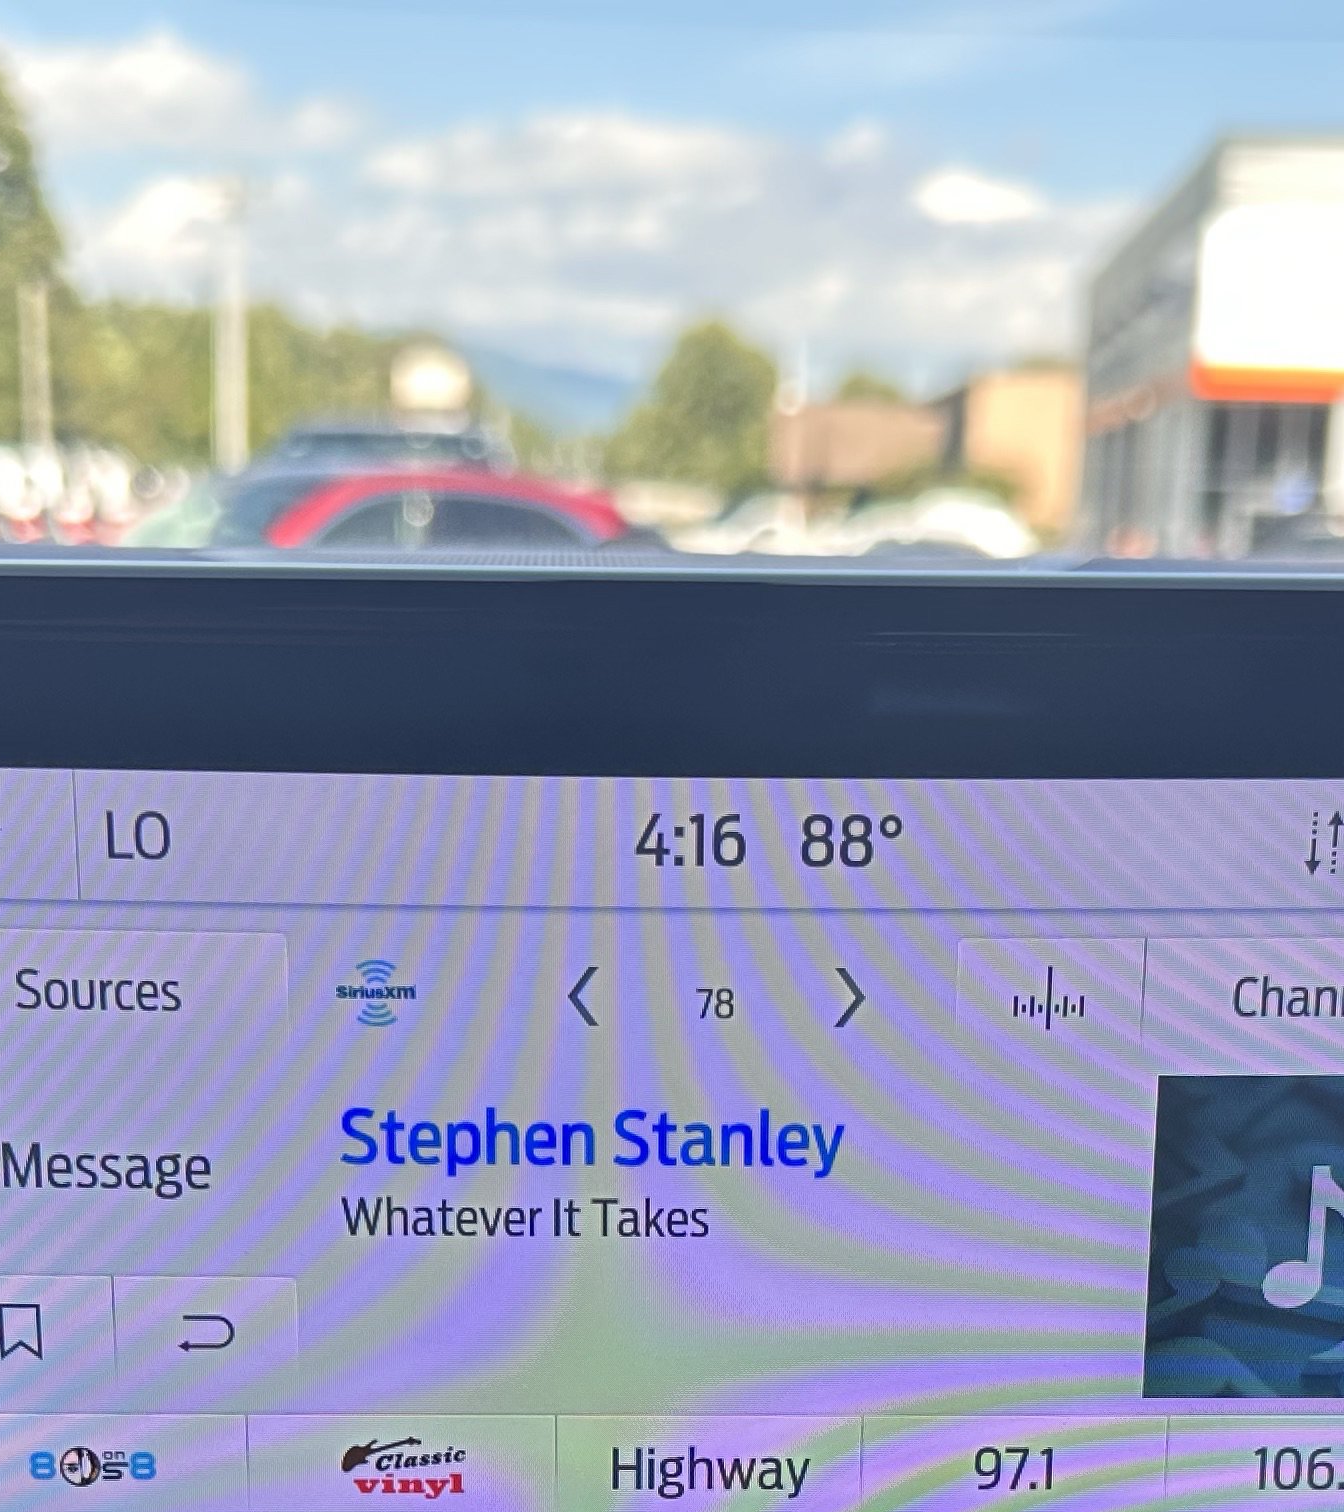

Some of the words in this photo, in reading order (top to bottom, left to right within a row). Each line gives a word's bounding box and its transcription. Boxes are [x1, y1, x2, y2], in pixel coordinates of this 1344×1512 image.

[105, 808, 172, 861] LO
[634, 812, 747, 868] 4:16
[14, 967, 183, 1013] Sources
[696, 987, 736, 1020] 78
[340, 1107, 596, 1177] Stephen
[612, 1108, 846, 1179] Stanley
[1, 1141, 213, 1199] Message
[342, 1197, 542, 1240] Whatever
[552, 1198, 582, 1240] It
[592, 1199, 712, 1241] Takes
[375, 1445, 466, 1471] Classic
[610, 1446, 811, 1500] Highway
[973, 1446, 1055, 1491] 97.1
[353, 1472, 464, 1499] vinyl
